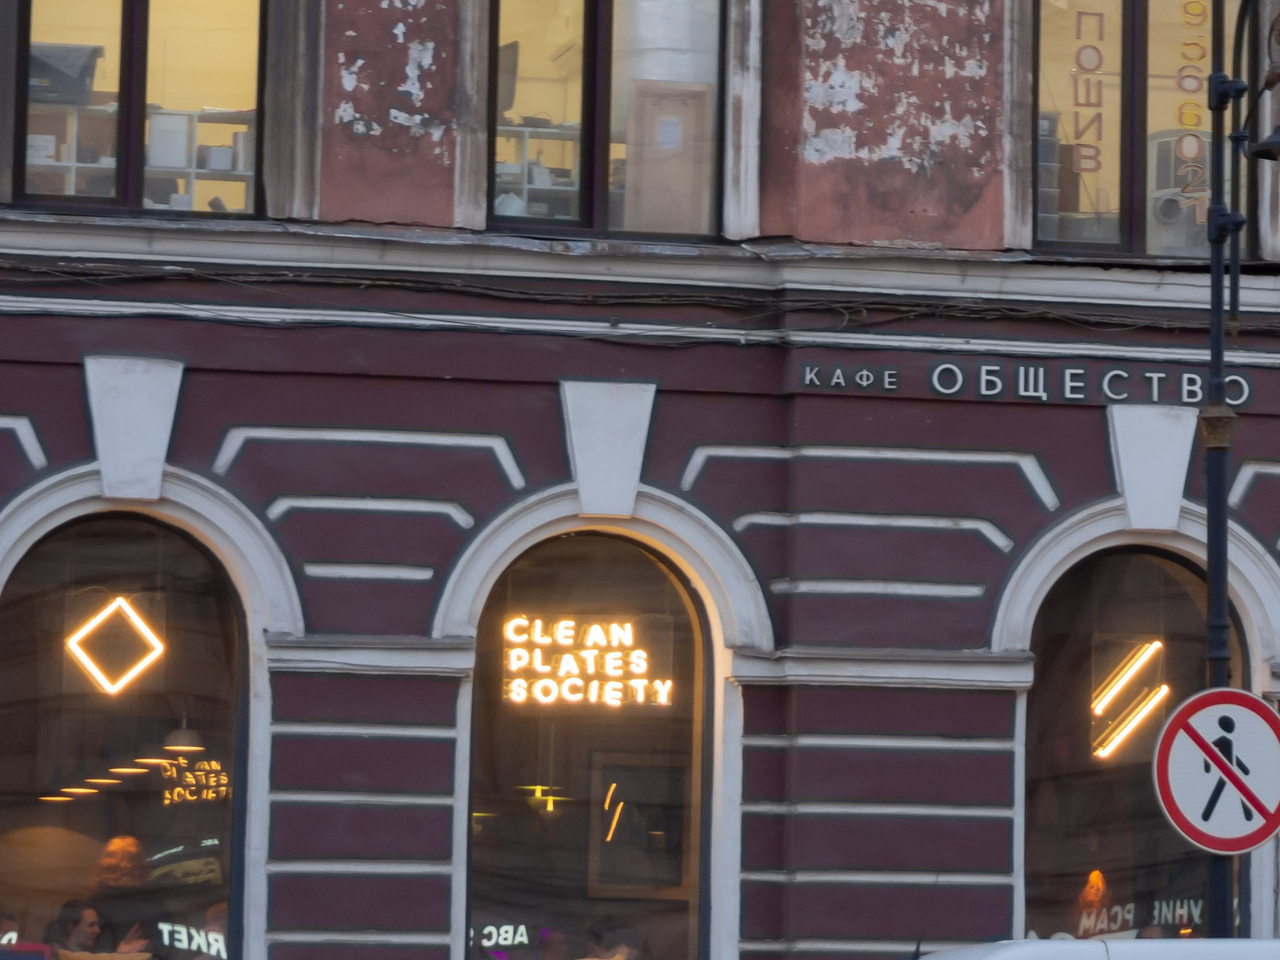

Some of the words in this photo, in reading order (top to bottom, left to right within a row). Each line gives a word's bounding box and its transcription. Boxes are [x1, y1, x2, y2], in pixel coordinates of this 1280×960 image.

[1073, 10, 1105, 173] ПОШИВ
[804, 365, 897, 389] КАФЕ
[932, 363, 1249, 406] ОБЩЕСТВО
[505, 617, 633, 647] CLEAN
[510, 647, 648, 677] PLATES
[509, 677, 673, 706] SOCIETY
